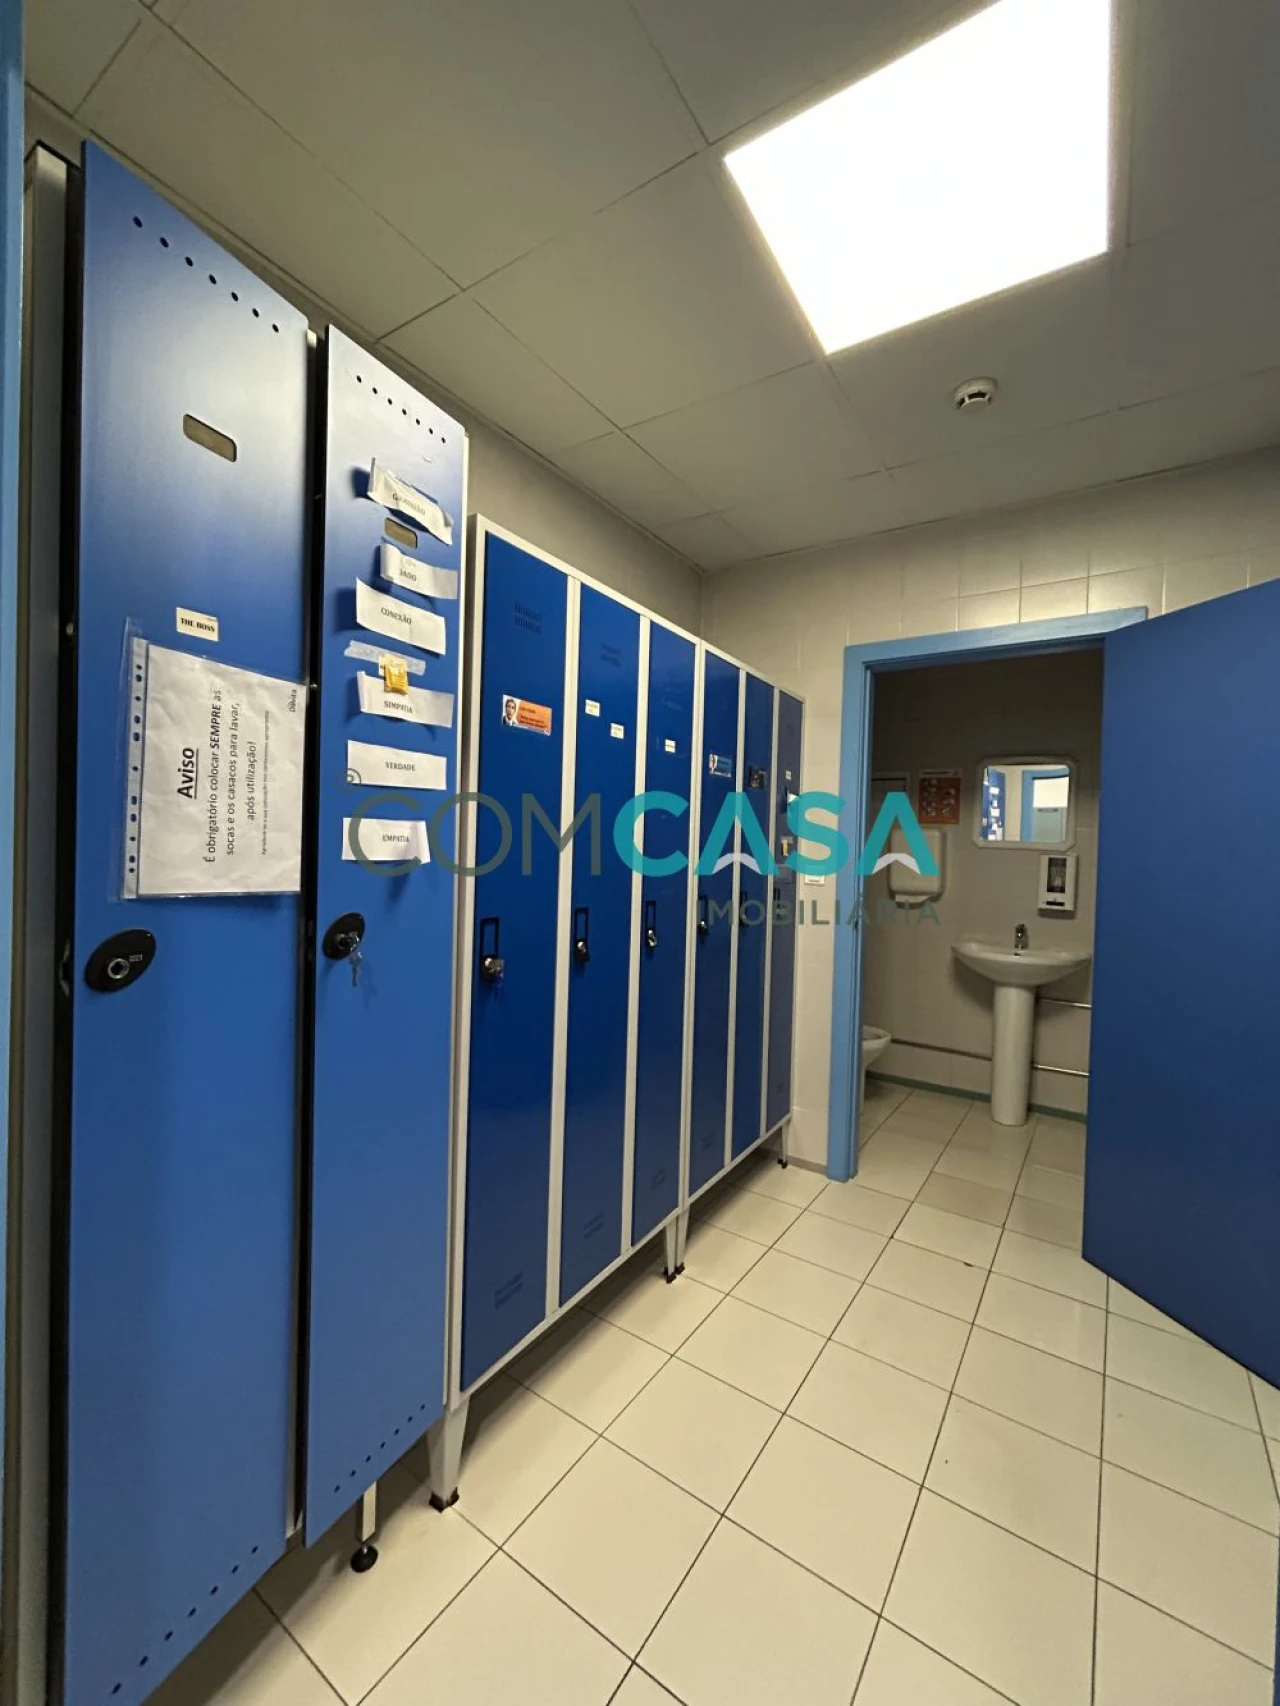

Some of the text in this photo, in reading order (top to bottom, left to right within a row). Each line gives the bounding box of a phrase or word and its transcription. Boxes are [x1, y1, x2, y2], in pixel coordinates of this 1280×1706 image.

[181, 617, 216, 632] THE BOSS
[381, 607, 412, 625] CONEXÃO
[229, 702, 241, 732] lavar,
[384, 700, 413, 714] SIMPATIA
[229, 733, 239, 758] para
[177, 747, 196, 799] Aviso
[202, 689, 222, 863] É obrigatório colocar SEMPRE as
[385, 761, 417, 772] VERDADE
[228, 759, 237, 800] casacos
[246, 740, 257, 821] após utilização!
[227, 803, 235, 815] os
[226, 826, 235, 855] socas
[382, 835, 410, 843] EMPATIA
